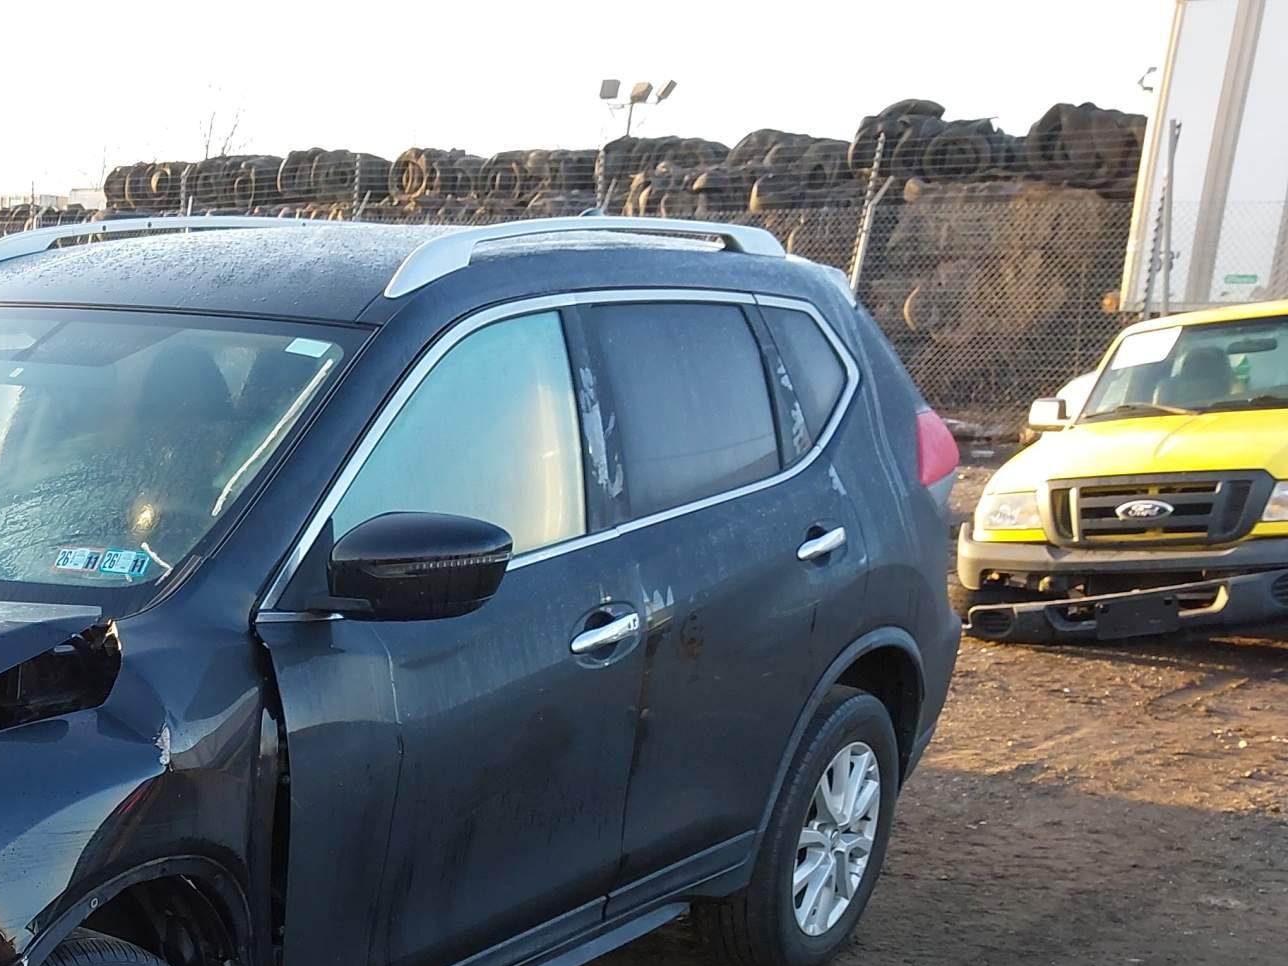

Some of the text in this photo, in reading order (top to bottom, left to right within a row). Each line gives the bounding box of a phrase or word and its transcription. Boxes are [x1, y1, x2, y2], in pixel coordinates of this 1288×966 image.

[56, 550, 100, 570] 26 11
[103, 553, 146, 573] 26 11
